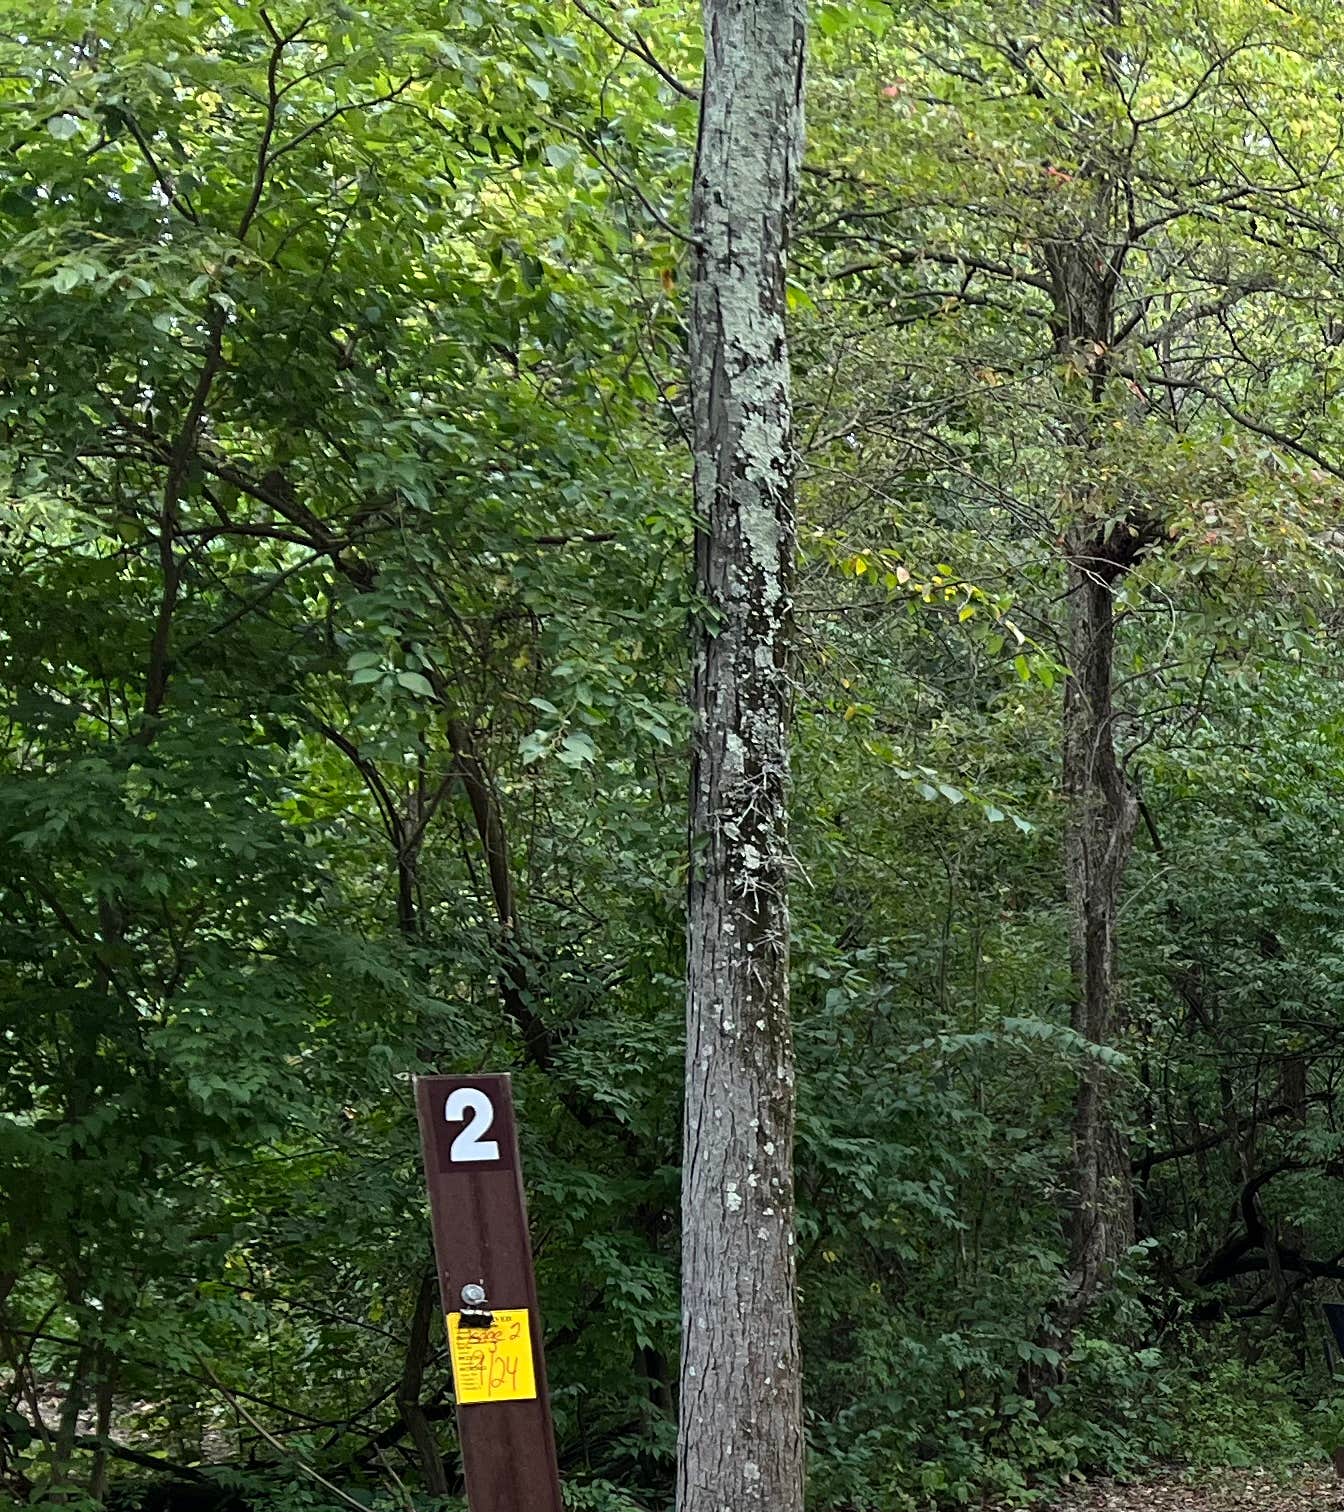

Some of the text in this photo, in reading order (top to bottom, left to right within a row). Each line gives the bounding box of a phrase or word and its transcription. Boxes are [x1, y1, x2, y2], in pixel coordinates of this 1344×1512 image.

[445, 1087, 500, 1162] 2
[509, 1322, 521, 1341] 2
[472, 1350, 519, 1396] 9/24
